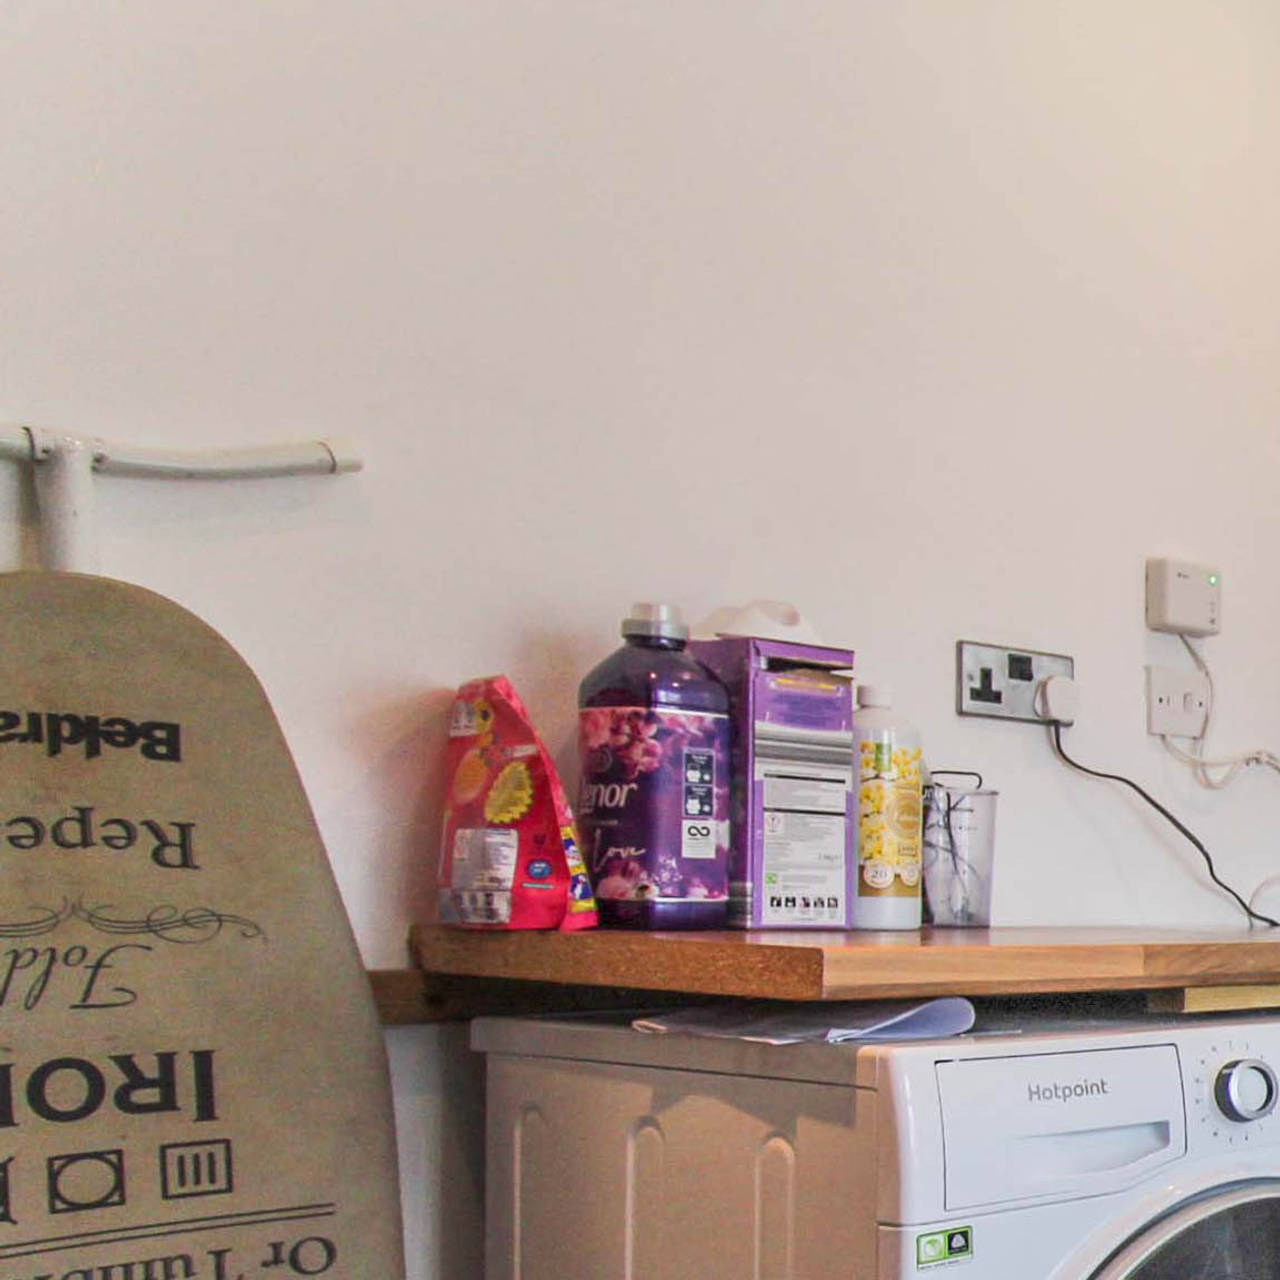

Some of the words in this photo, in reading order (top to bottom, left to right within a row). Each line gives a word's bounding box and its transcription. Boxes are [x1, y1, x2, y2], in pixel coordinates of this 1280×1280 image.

[0, 806, 201, 871] Repe
[0, 944, 152, 1011] Fold
[1027, 1078, 1110, 1103] Hotpoint
[261, 1236, 337, 1276] Or
